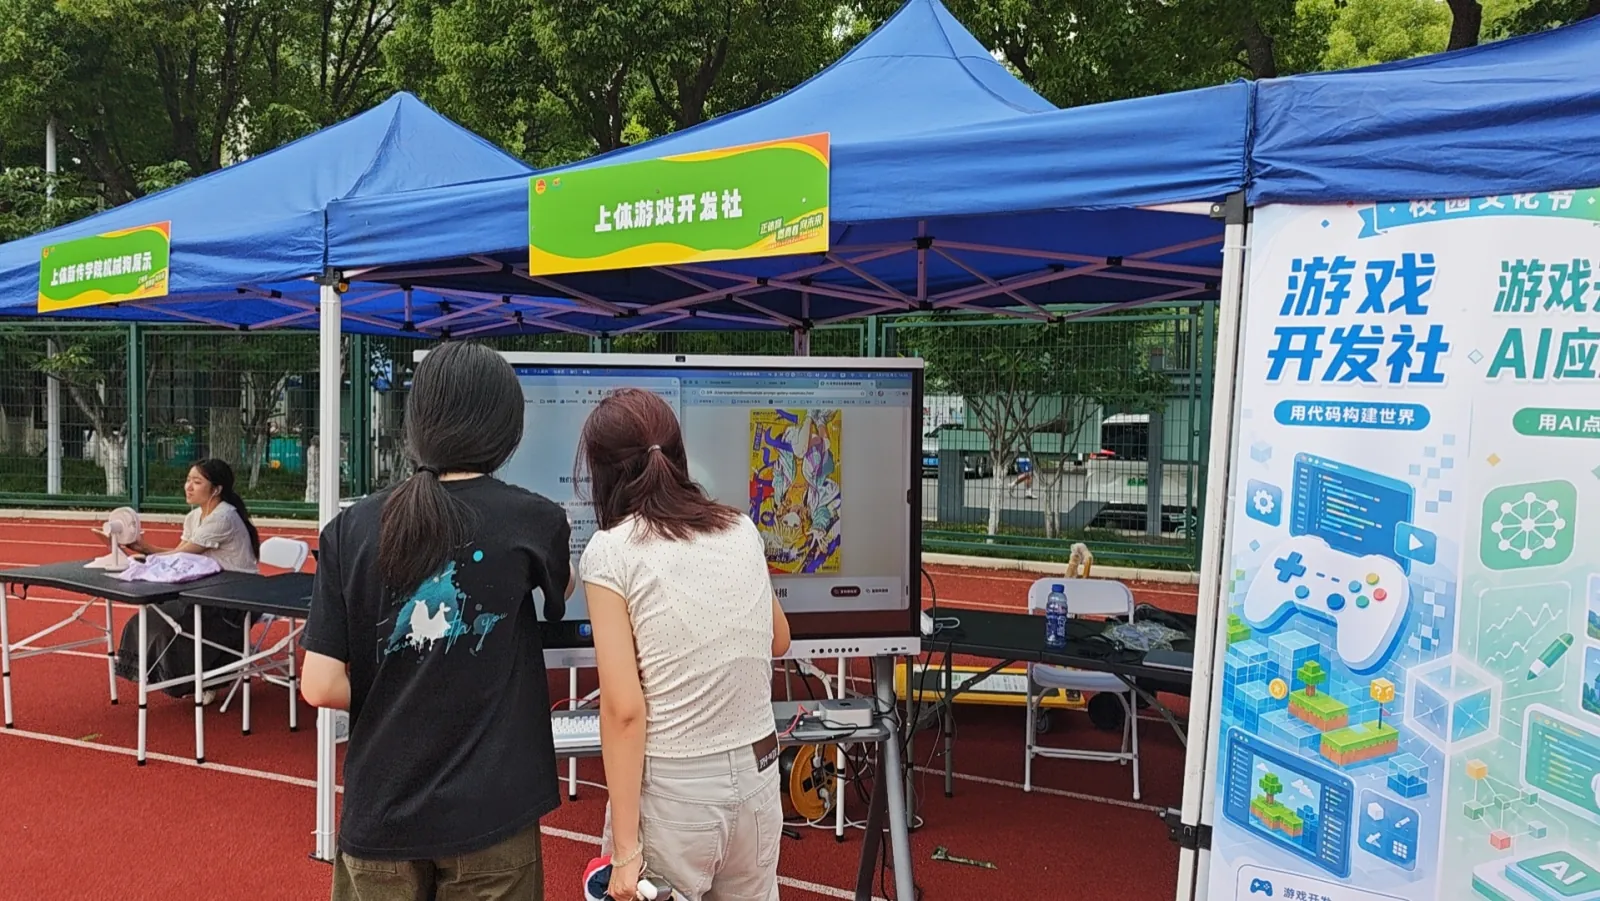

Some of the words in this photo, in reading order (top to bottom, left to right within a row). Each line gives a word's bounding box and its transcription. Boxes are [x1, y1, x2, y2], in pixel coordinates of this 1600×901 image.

[594, 188, 743, 232] 上体游戏开发社
[50, 251, 152, 286] 上体新传学院机械狗展示
[1279, 252, 1436, 316] 游戏
[1493, 258, 1600, 312] 游戏
[1265, 323, 1450, 385] 开发社
[1486, 326, 1600, 380] AI应
[1290, 404, 1415, 426] 用代码构建世界
[1538, 413, 1600, 433] 用AI点
[1539, 861, 1587, 886] AI
